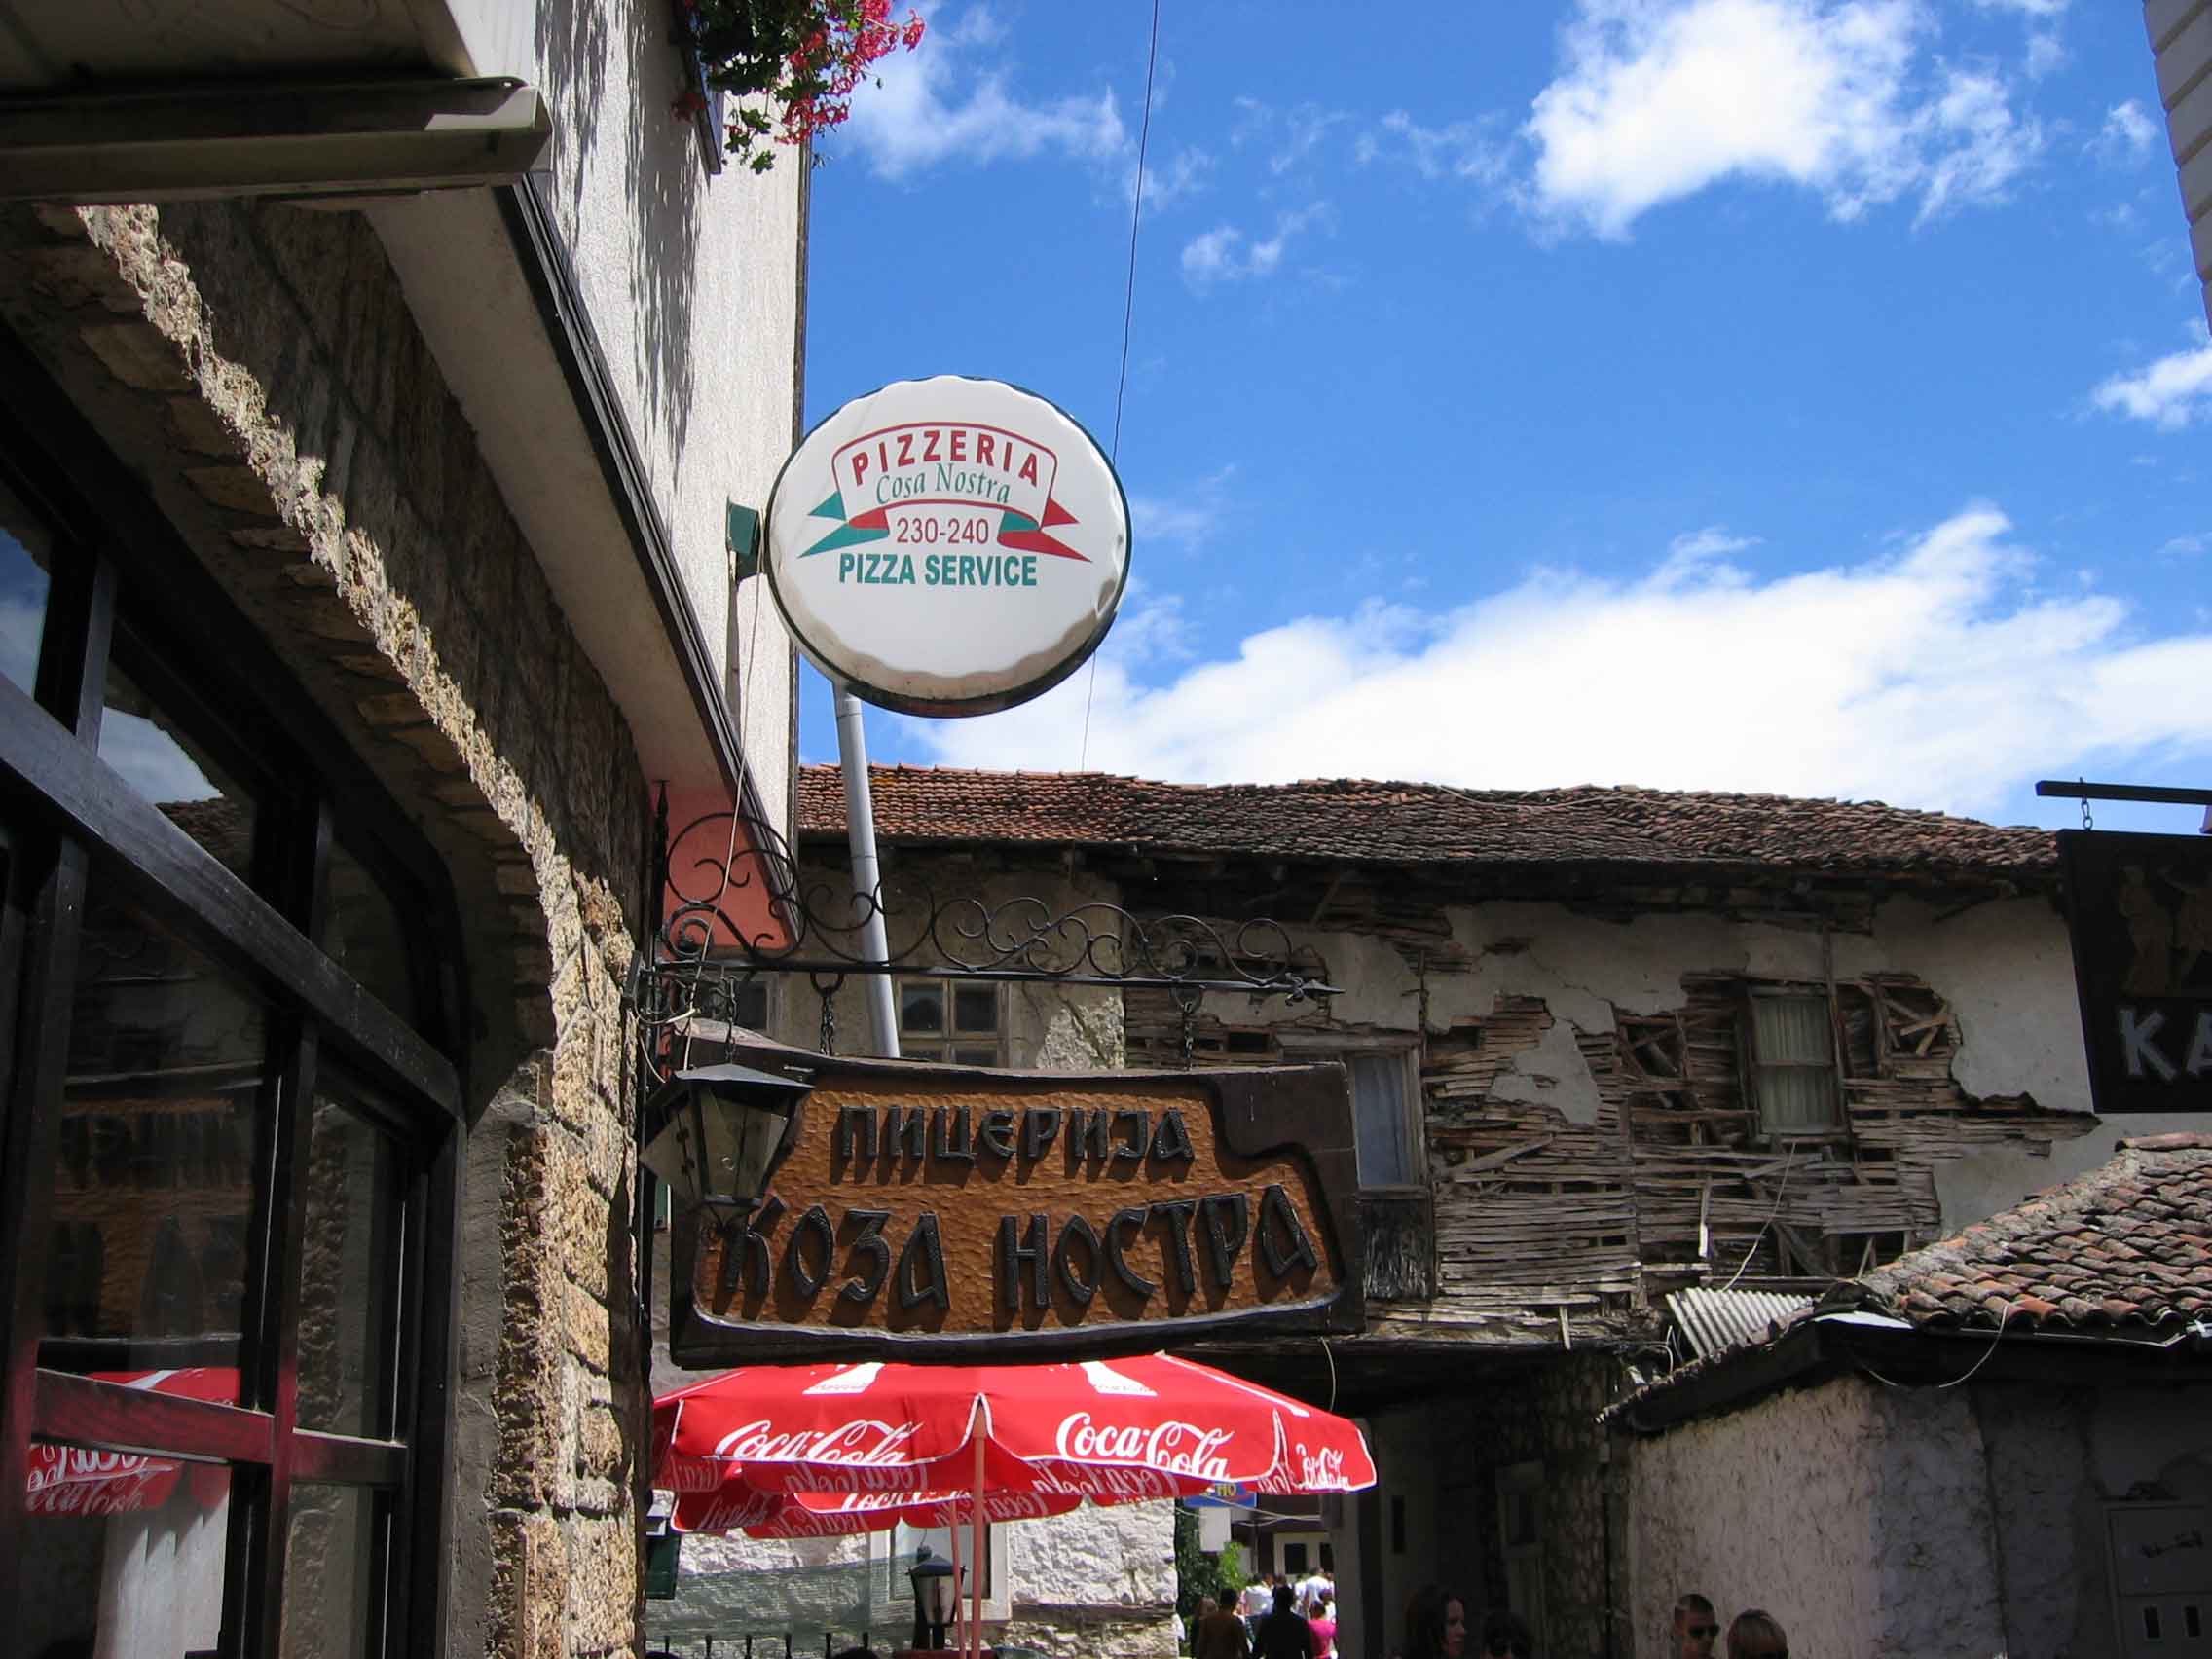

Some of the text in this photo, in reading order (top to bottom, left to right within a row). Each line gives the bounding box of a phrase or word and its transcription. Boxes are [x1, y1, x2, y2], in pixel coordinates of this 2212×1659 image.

[852, 430, 1038, 487] PIZZERIA
[875, 461, 1011, 505] Cosa Nostra
[896, 517, 990, 545] 230-240
[838, 552, 1038, 586] PIZZA SERVICE
[839, 1104, 1198, 1163] ПИЦЕРИЈА
[725, 1183, 1319, 1311] КОЗА НОСТРА
[716, 1419, 924, 1465] Coca-Cola
[1055, 1412, 1235, 1480] Coca-Cola
